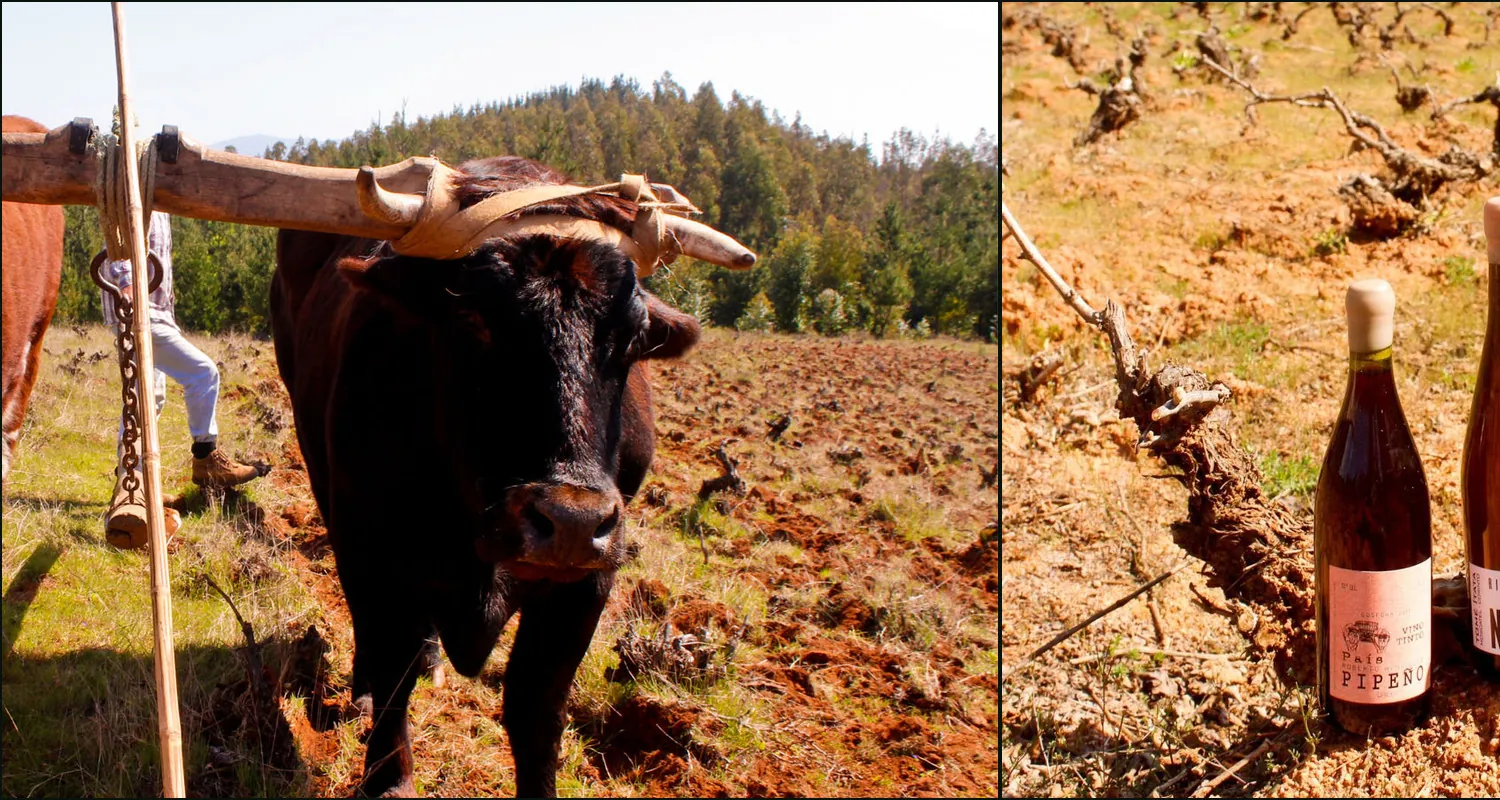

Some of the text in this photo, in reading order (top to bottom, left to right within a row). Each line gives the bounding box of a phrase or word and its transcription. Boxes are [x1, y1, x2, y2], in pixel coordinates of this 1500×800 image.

[1401, 621, 1425, 635] VINO
[1396, 631, 1425, 646] TINTO
[1341, 651, 1384, 665] País
[1341, 664, 1424, 690] PIPEÑO
